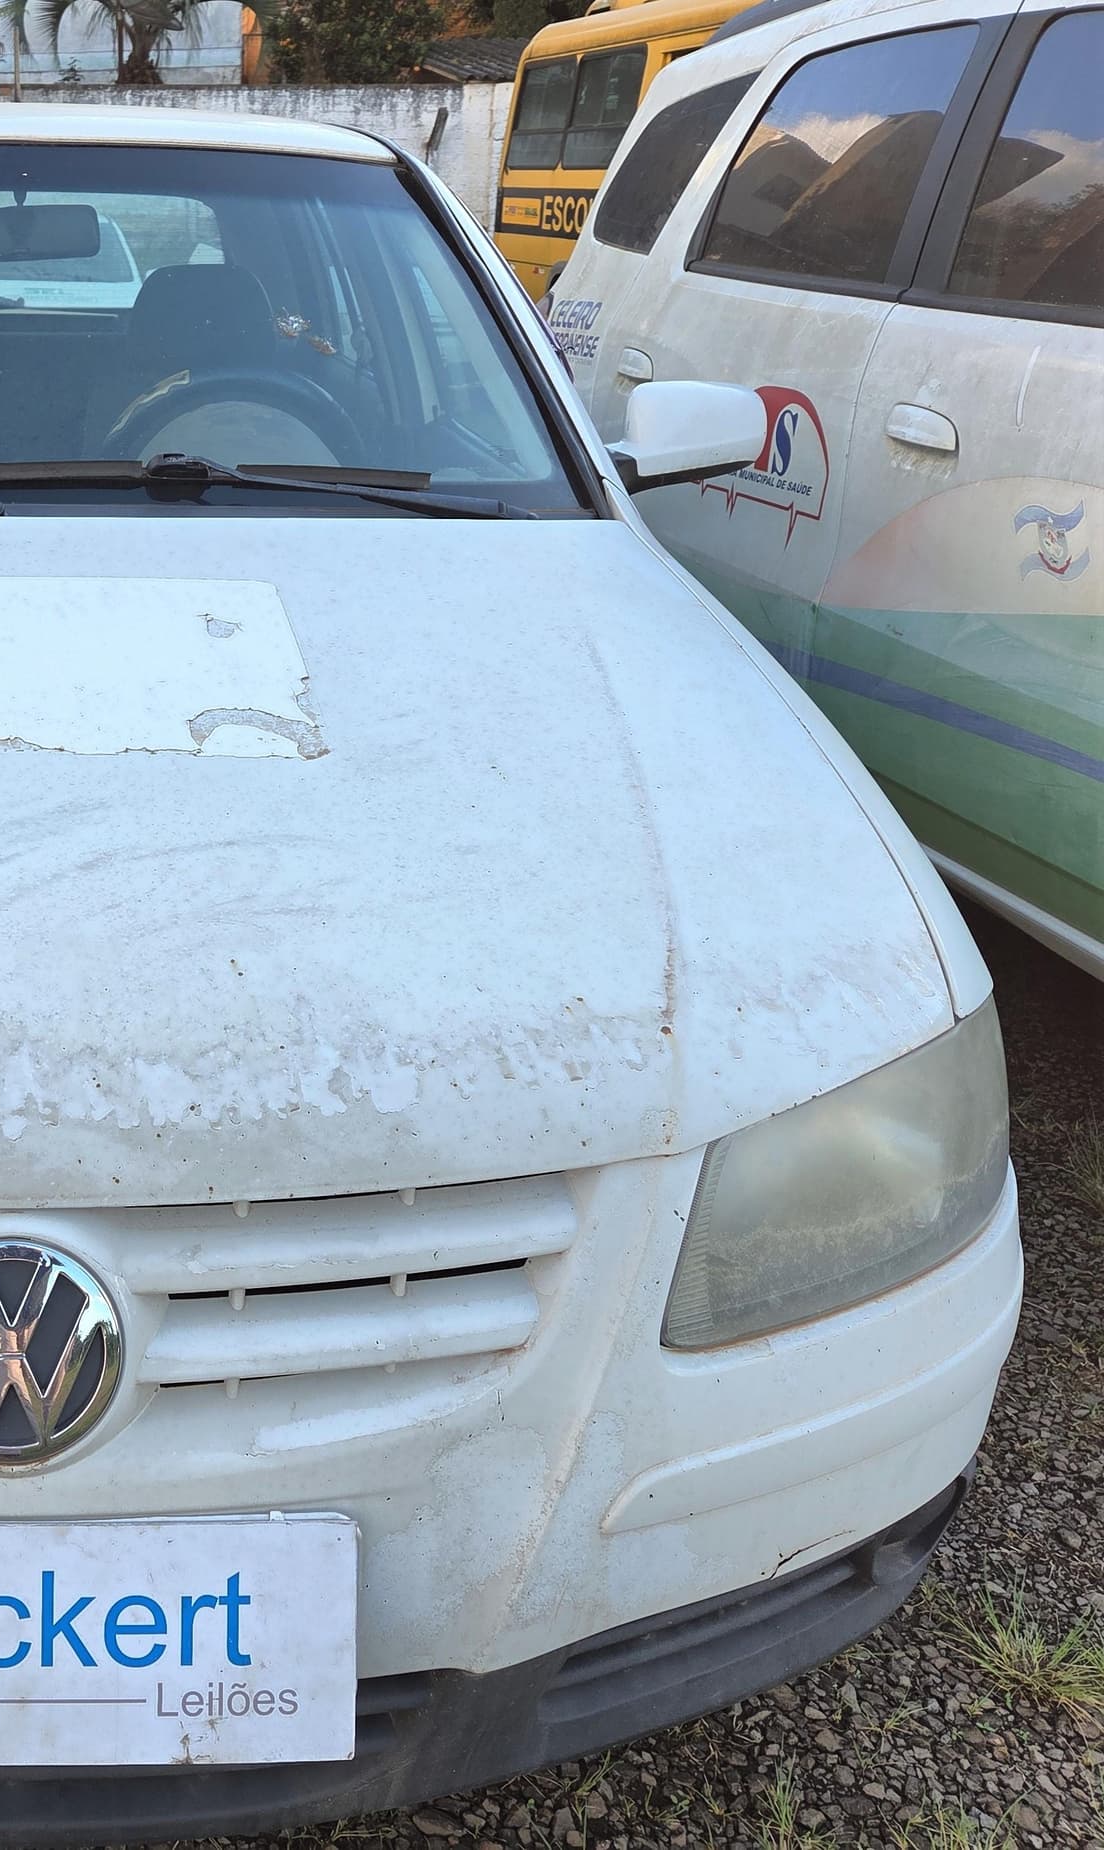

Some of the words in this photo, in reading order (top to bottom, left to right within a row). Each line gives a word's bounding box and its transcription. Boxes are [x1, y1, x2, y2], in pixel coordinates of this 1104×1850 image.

[542, 195, 594, 234] ESCO
[551, 300, 602, 330] CELEIRO
[739, 468, 775, 487] MUNICIPAL
[776, 479, 789, 490] DE
[156, 1681, 299, 1718] Leilões
